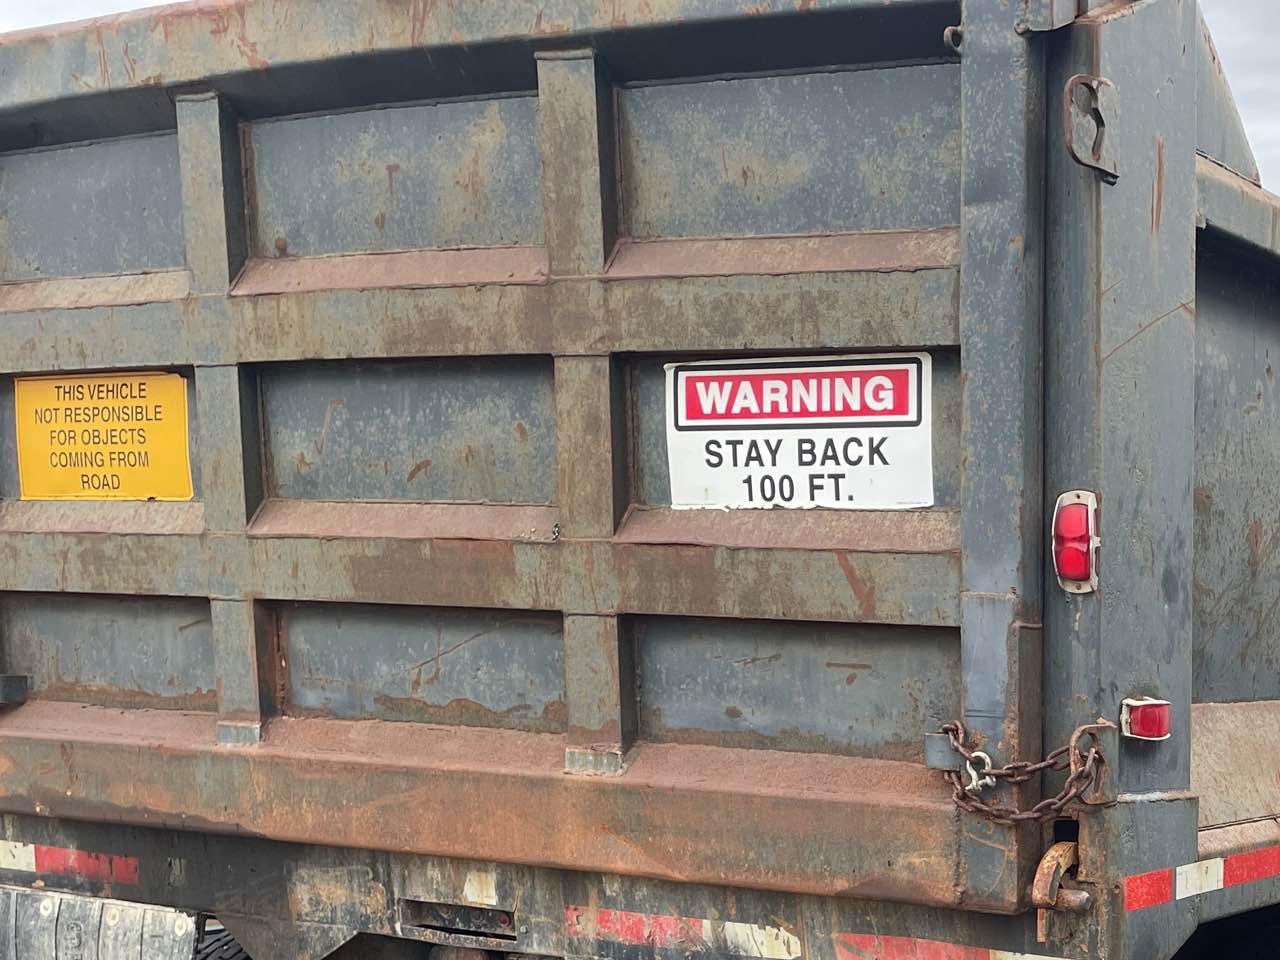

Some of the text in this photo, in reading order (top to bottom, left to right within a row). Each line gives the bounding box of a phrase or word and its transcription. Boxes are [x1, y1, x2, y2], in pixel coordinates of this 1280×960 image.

[54, 382, 147, 401] THIS VEHICLE
[695, 375, 894, 415] WARNING
[35, 405, 163, 424] NOT RESPONSIBLE
[50, 428, 147, 446] FOR OBJECTS
[50, 451, 149, 468] COMING FROM
[704, 436, 891, 468] STAY BACK
[81, 474, 121, 490] ROAD
[742, 473, 854, 502] 100 FT.
